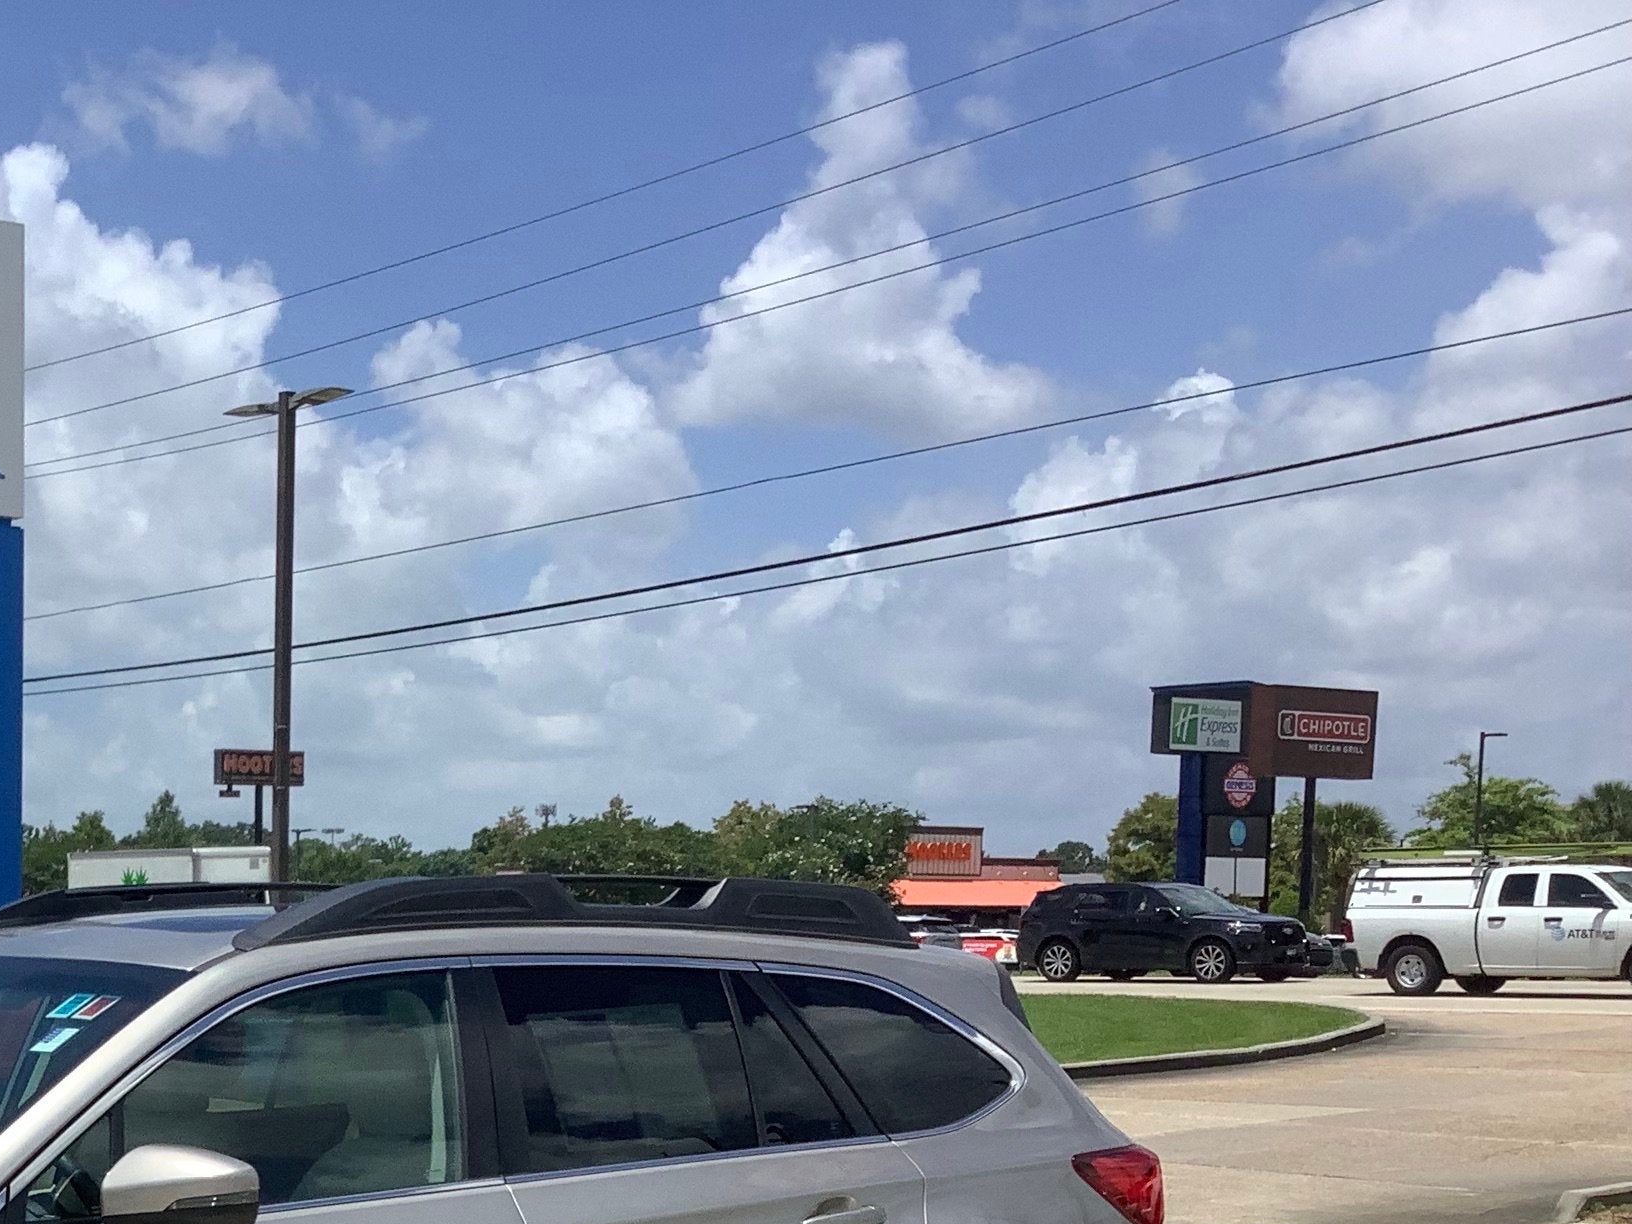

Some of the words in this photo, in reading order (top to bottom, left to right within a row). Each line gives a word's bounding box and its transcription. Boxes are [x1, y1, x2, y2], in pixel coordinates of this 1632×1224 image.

[1200, 717, 1239, 735] Express
[1299, 718, 1367, 737] CHIPOTLE
[1308, 743, 1342, 753] MEXICAN
[1342, 746, 1364, 755] GRILL
[223, 753, 303, 775] HOOTS
[1568, 928, 1594, 939] AT&T
